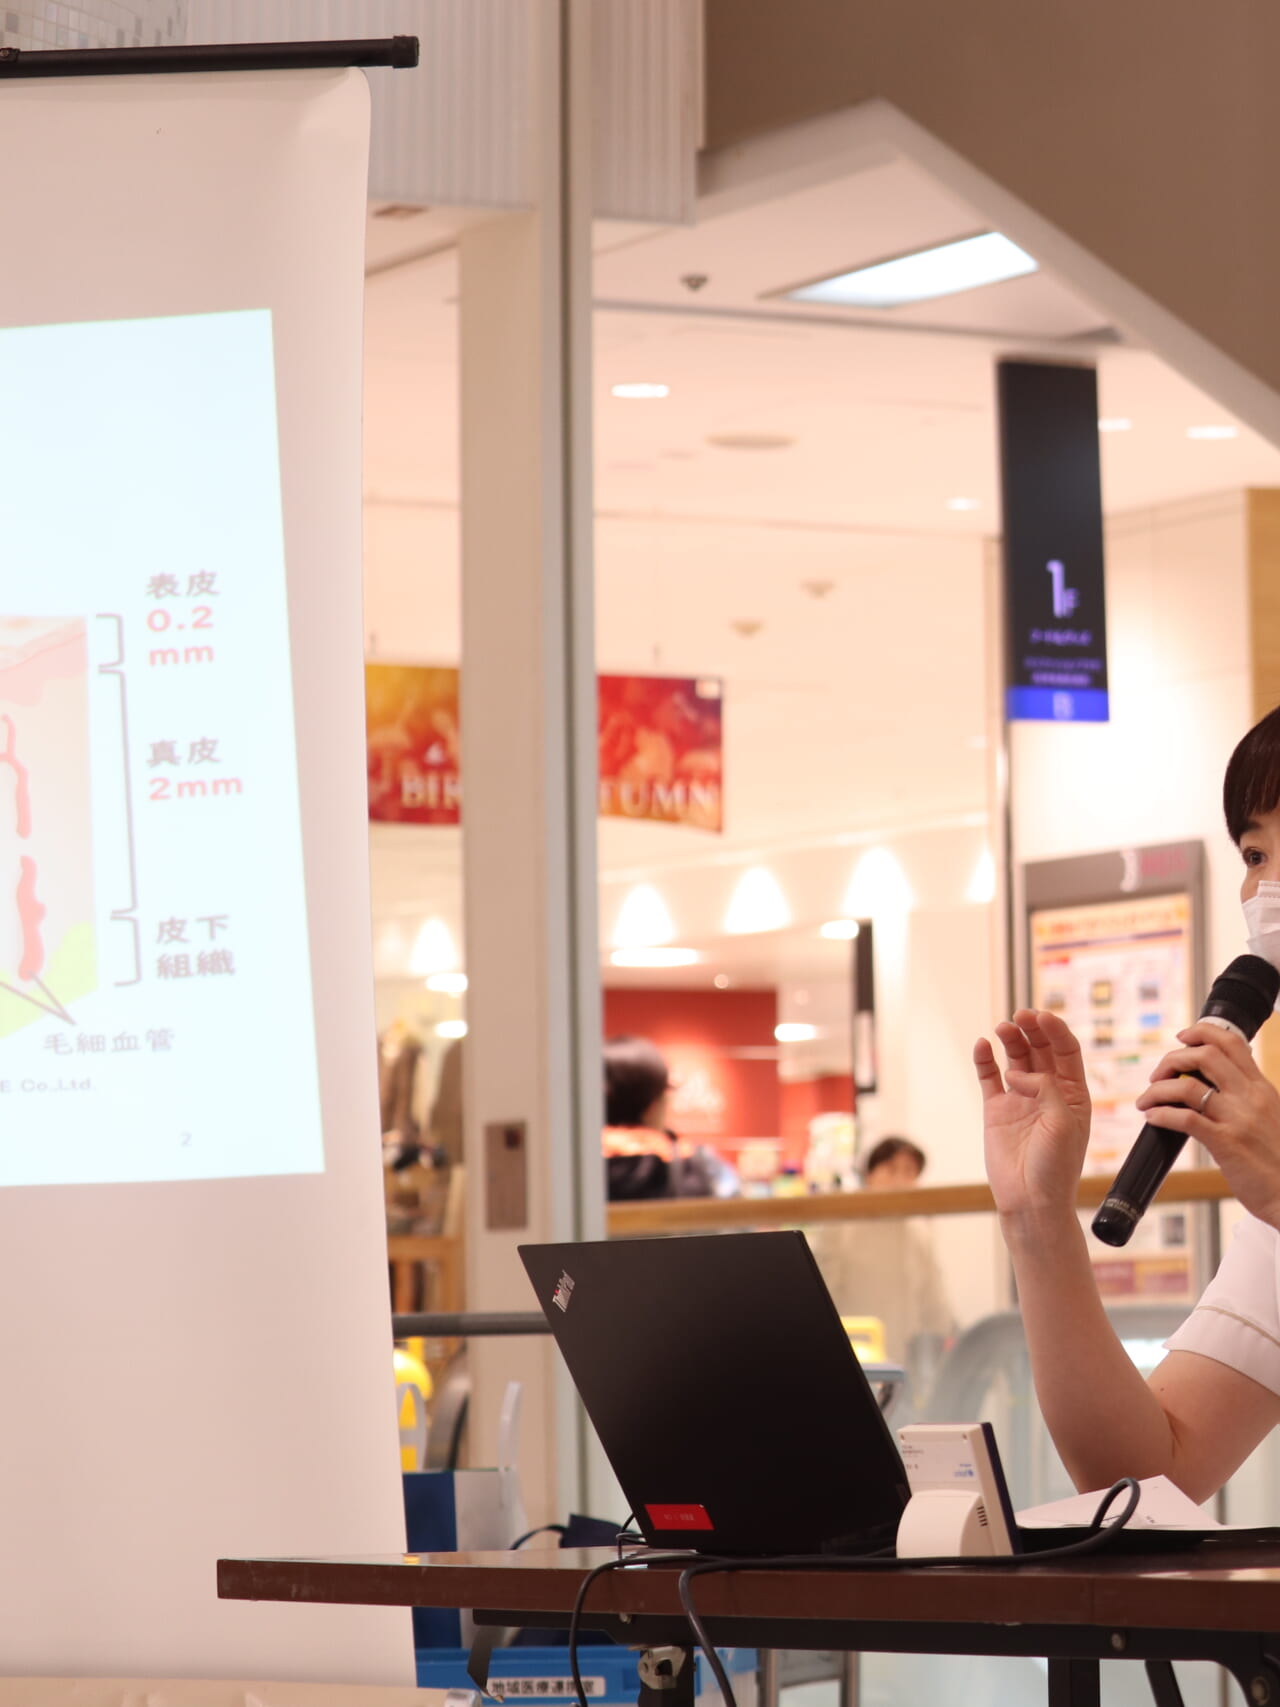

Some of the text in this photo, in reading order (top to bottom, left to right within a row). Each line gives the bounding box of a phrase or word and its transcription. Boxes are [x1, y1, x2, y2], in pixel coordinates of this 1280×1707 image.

[147, 570, 220, 598] 表皮
[147, 606, 214, 632] 0.2
[149, 645, 214, 665] mm
[147, 738, 221, 767] 真皮
[149, 777, 243, 801] 2mm
[156, 914, 230, 944] 皮下
[156, 949, 236, 979] 組織
[44, 1028, 175, 1055] 毛細血管
[181, 1131, 192, 1147] 2
